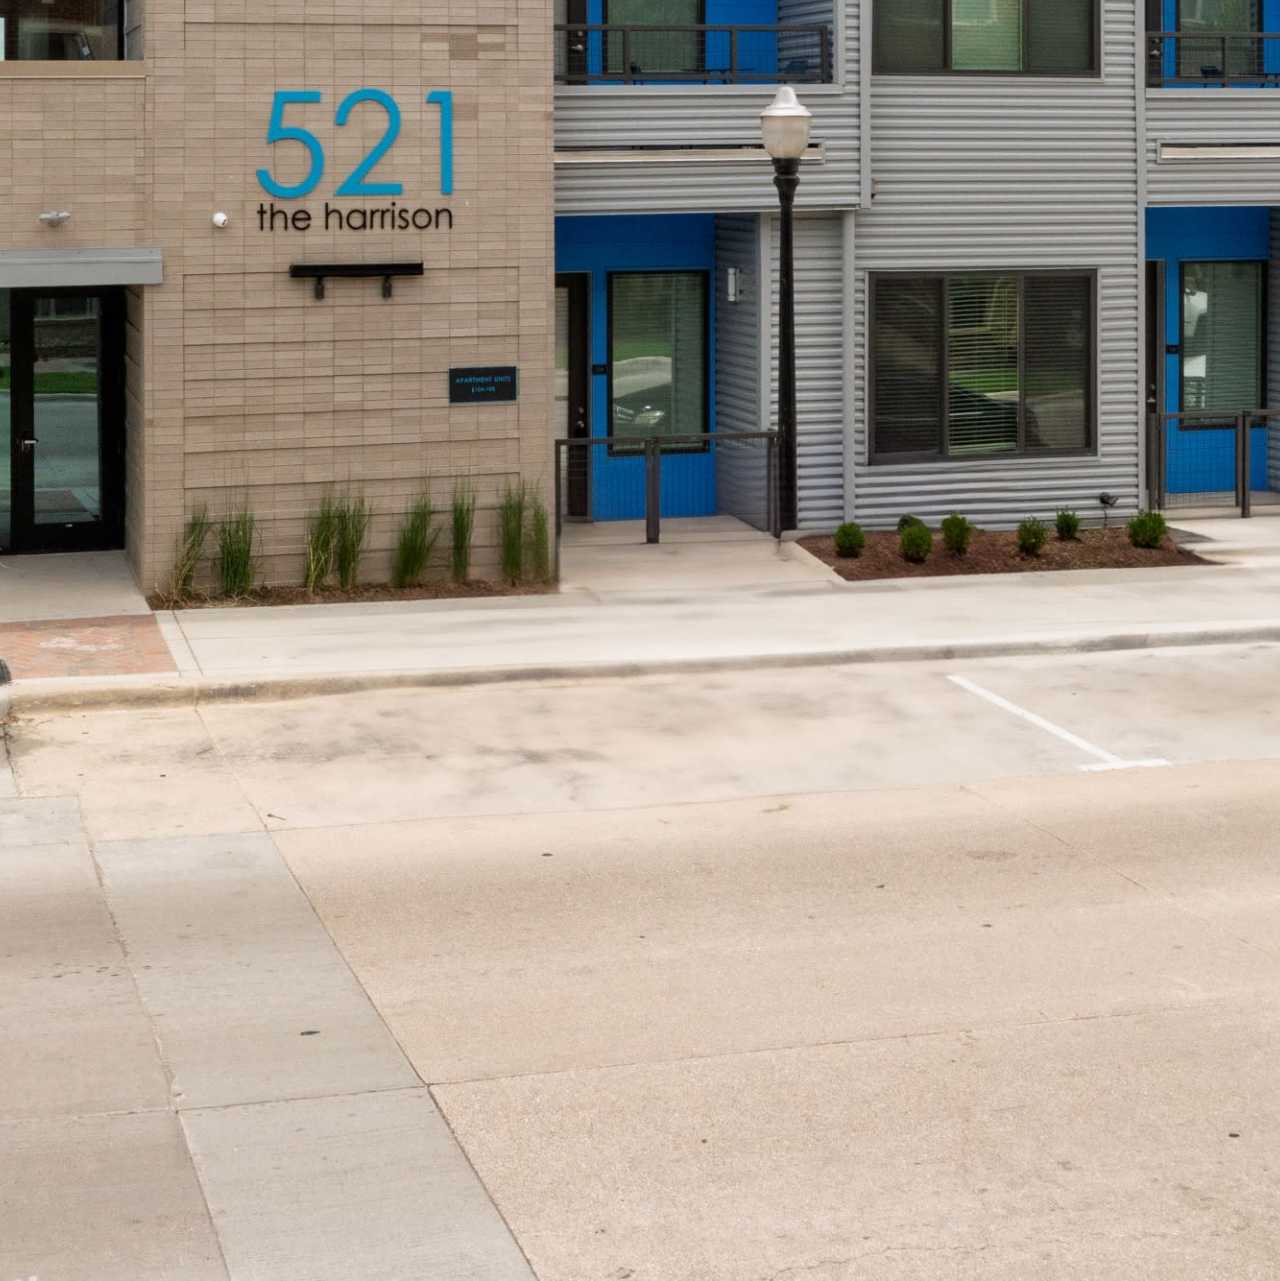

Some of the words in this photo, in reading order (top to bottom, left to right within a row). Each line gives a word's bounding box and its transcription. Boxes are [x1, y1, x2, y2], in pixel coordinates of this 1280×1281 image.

[256, 88, 453, 199] 521
[257, 203, 312, 231] the
[324, 202, 453, 231] harrison
